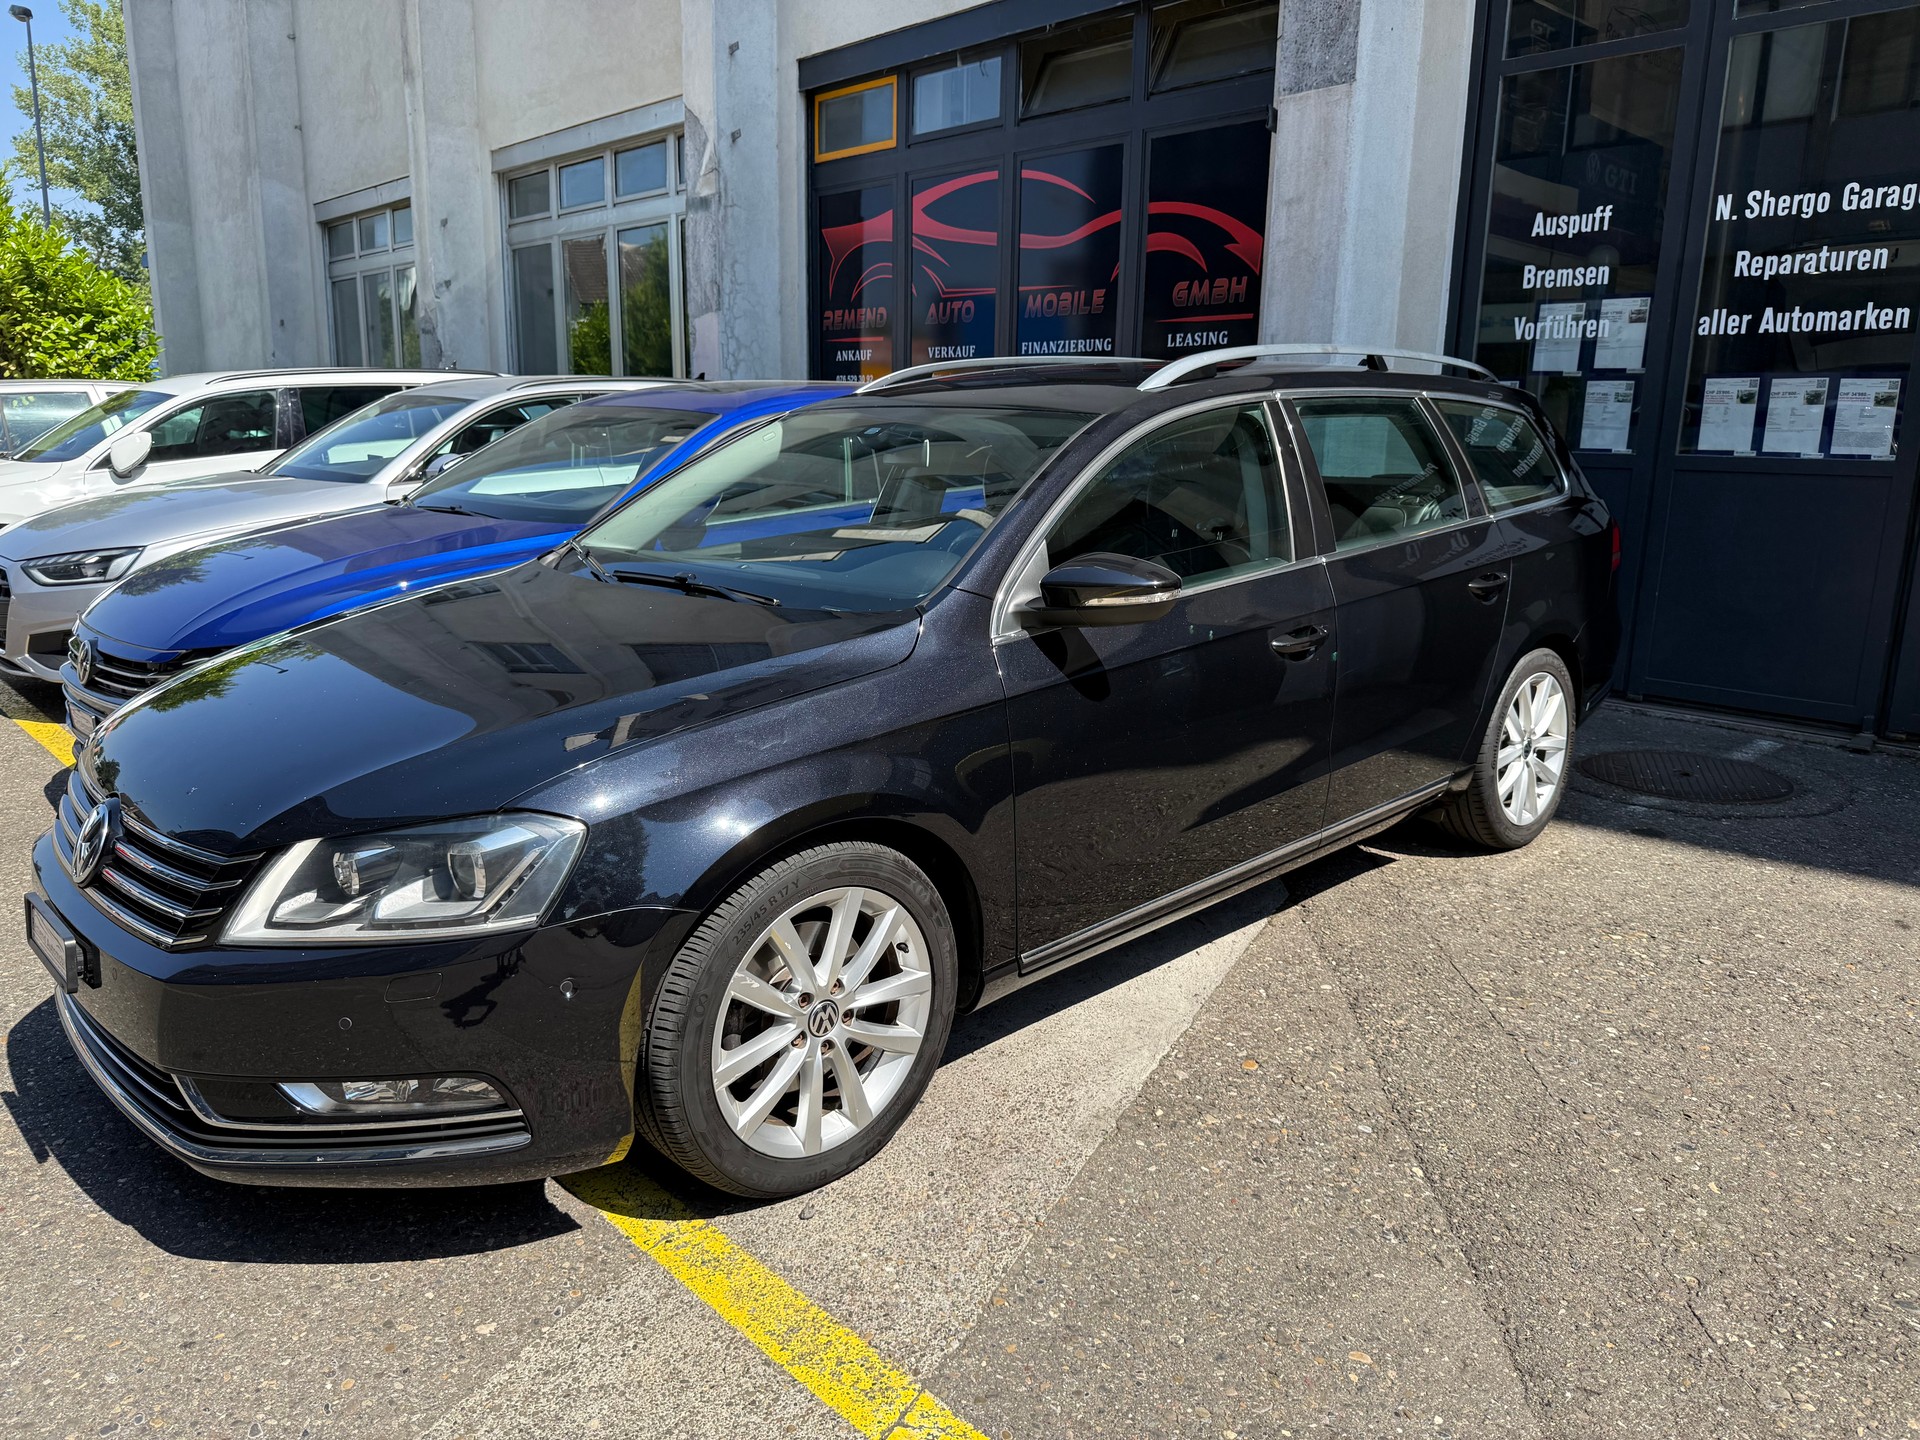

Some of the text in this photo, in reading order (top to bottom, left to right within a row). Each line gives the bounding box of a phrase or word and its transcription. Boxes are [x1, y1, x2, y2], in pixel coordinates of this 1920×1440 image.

[1605, 164, 1638, 195] GTI
[1715, 182, 1920, 221] N. Shergo Garag
[1531, 204, 1613, 238] Auspuff
[1522, 265, 1610, 289] Bremsen
[1734, 245, 1889, 281] Reparaturen
[822, 276, 1248, 331] REMEND AUTO MOBILE GMBH
[1698, 301, 1910, 336] aller Automarken
[1167, 330, 1228, 347] LEASING
[1513, 313, 1610, 340] Vorführen
[835, 349, 872, 362] ANKAUF
[927, 345, 976, 359] VERKAUF
[1021, 338, 1112, 354] FINANZIERUNG
[732, 879, 801, 946] 235/45 R 17 Y
